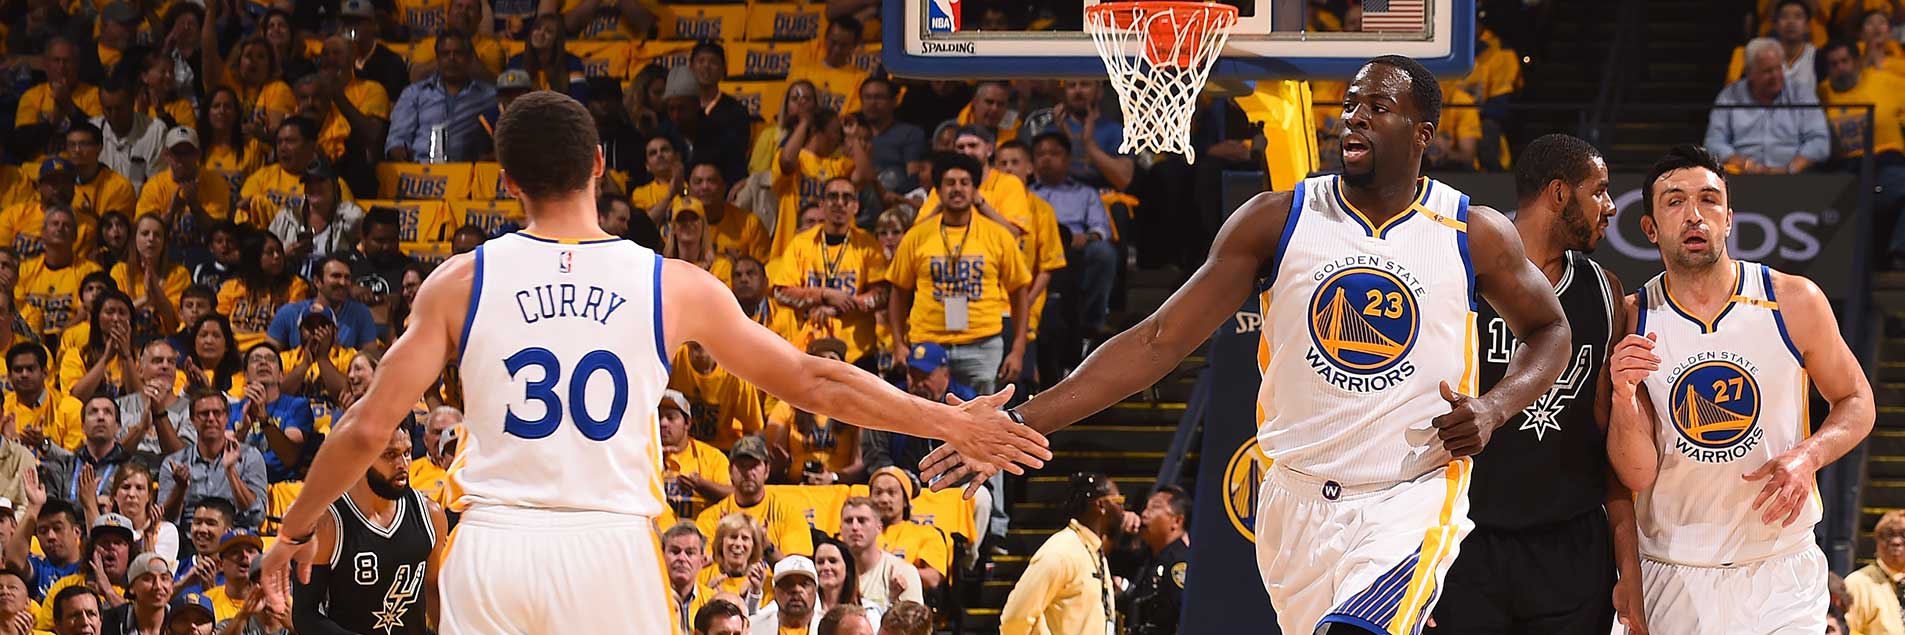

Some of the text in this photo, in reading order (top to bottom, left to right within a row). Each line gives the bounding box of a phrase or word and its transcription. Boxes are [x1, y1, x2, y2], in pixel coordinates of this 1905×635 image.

[932, 17, 950, 29] NBA
[922, 41, 975, 54] SPALDING
[399, 174, 447, 198] DUBS
[1313, 256, 1426, 298] GOLDEN STATE
[516, 284, 627, 325] CURRY
[1363, 289, 1404, 319] 23
[1305, 346, 1416, 393] WARRIORS
[1667, 351, 1759, 384] GOLDEN STATE
[502, 347, 629, 442] 30
[1712, 376, 1744, 404] 27
[1675, 426, 1764, 463] WARRIORS
[354, 552, 379, 585] 8
